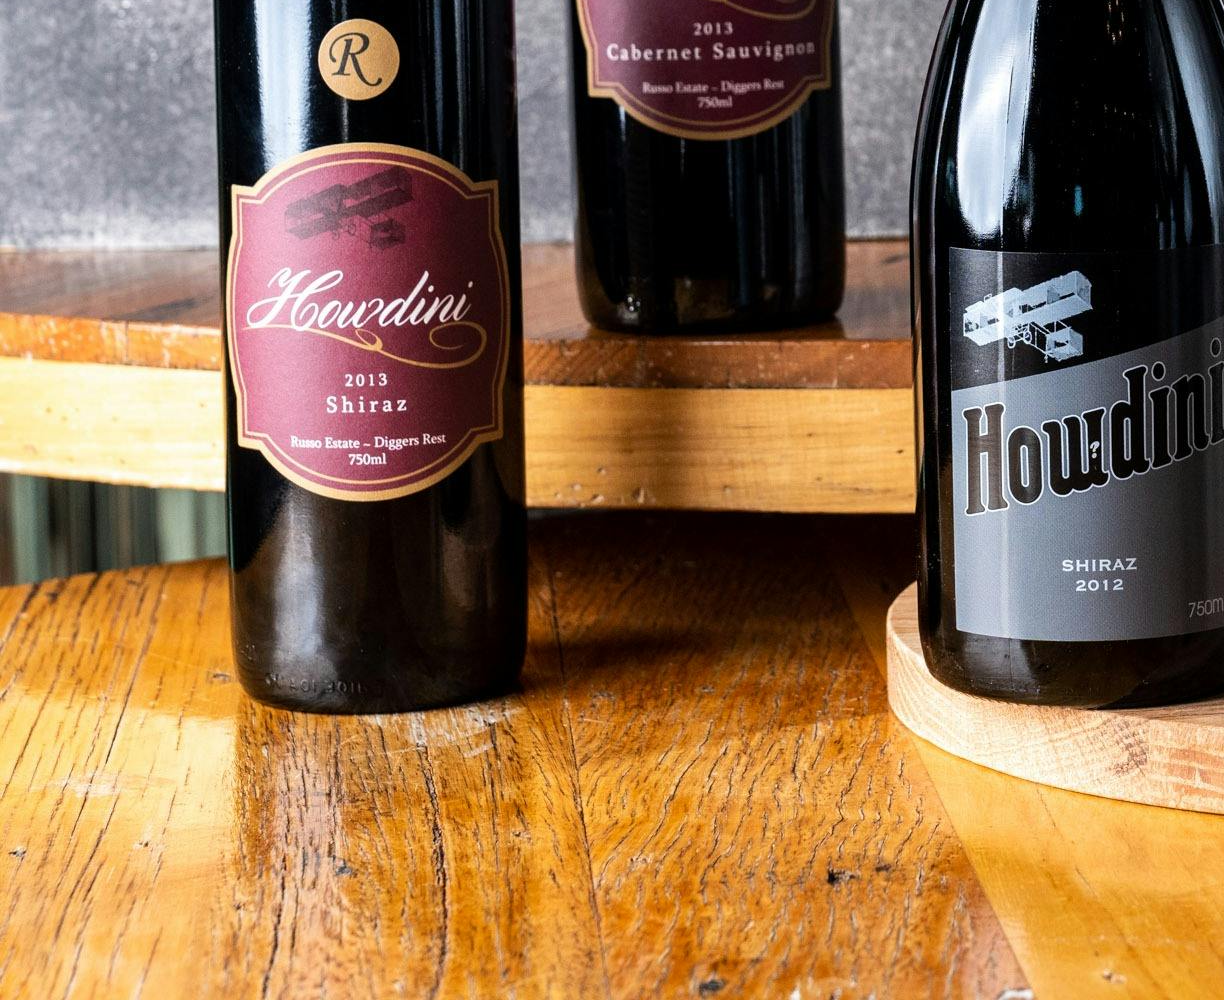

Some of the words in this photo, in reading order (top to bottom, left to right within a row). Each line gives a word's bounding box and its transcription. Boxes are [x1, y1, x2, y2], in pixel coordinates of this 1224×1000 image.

[693, 22, 734, 36] 2013
[329, 32, 382, 86] R
[606, 43, 702, 61] Cabernet
[712, 42, 815, 62] Sauvignon
[720, 79, 761, 95] Diggers
[697, 96, 733, 109] 750ml
[344, 372, 388, 387] 2013
[326, 395, 407, 414] Shiraz
[290, 435, 322, 449] Russo
[324, 436, 360, 449] Estate
[373, 434, 419, 450] Diggers
[422, 433, 446, 444] Rest
[348, 453, 387, 466] 750ml
[1061, 557, 1138, 573] SHIRAZ
[1075, 578, 1124, 592] 2012
